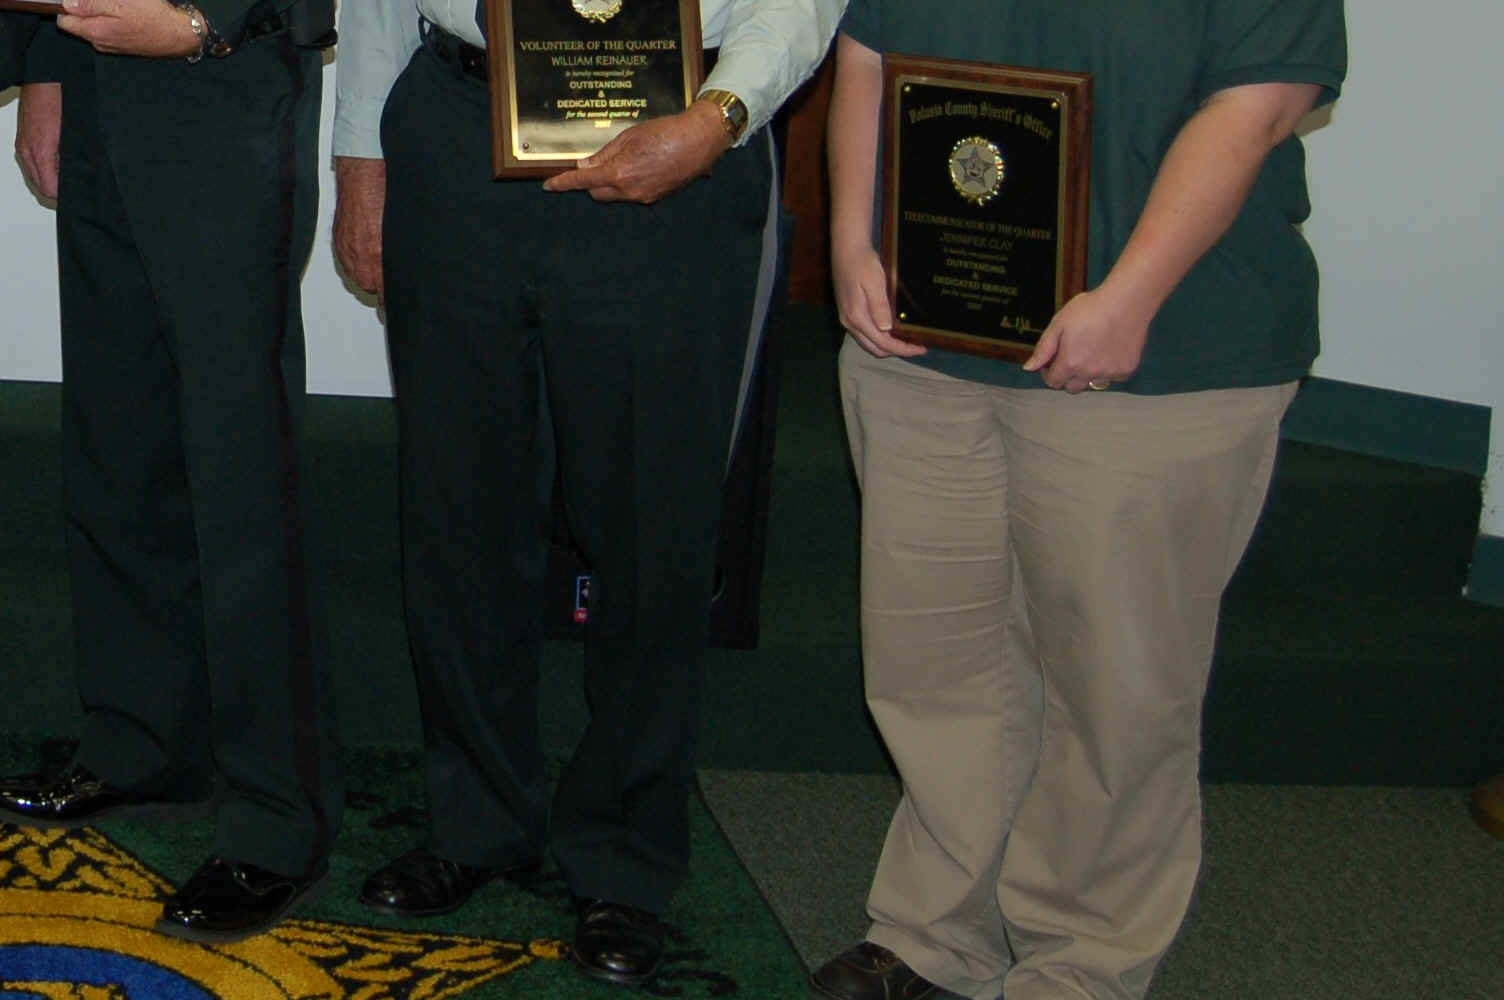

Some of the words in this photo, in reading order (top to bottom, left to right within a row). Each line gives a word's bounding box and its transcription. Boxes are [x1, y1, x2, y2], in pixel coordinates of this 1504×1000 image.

[520, 41, 584, 51] VOLUNTEER
[586, 41, 600, 51] OF
[604, 41, 624, 50] THE
[625, 40, 676, 51] QUARTER
[551, 55, 593, 66] WILLIAM
[595, 55, 648, 65] REINAUER
[569, 81, 632, 89] OUTSTANDING
[556, 99, 608, 108] DEDICATED
[608, 99, 647, 108] SERVICE
